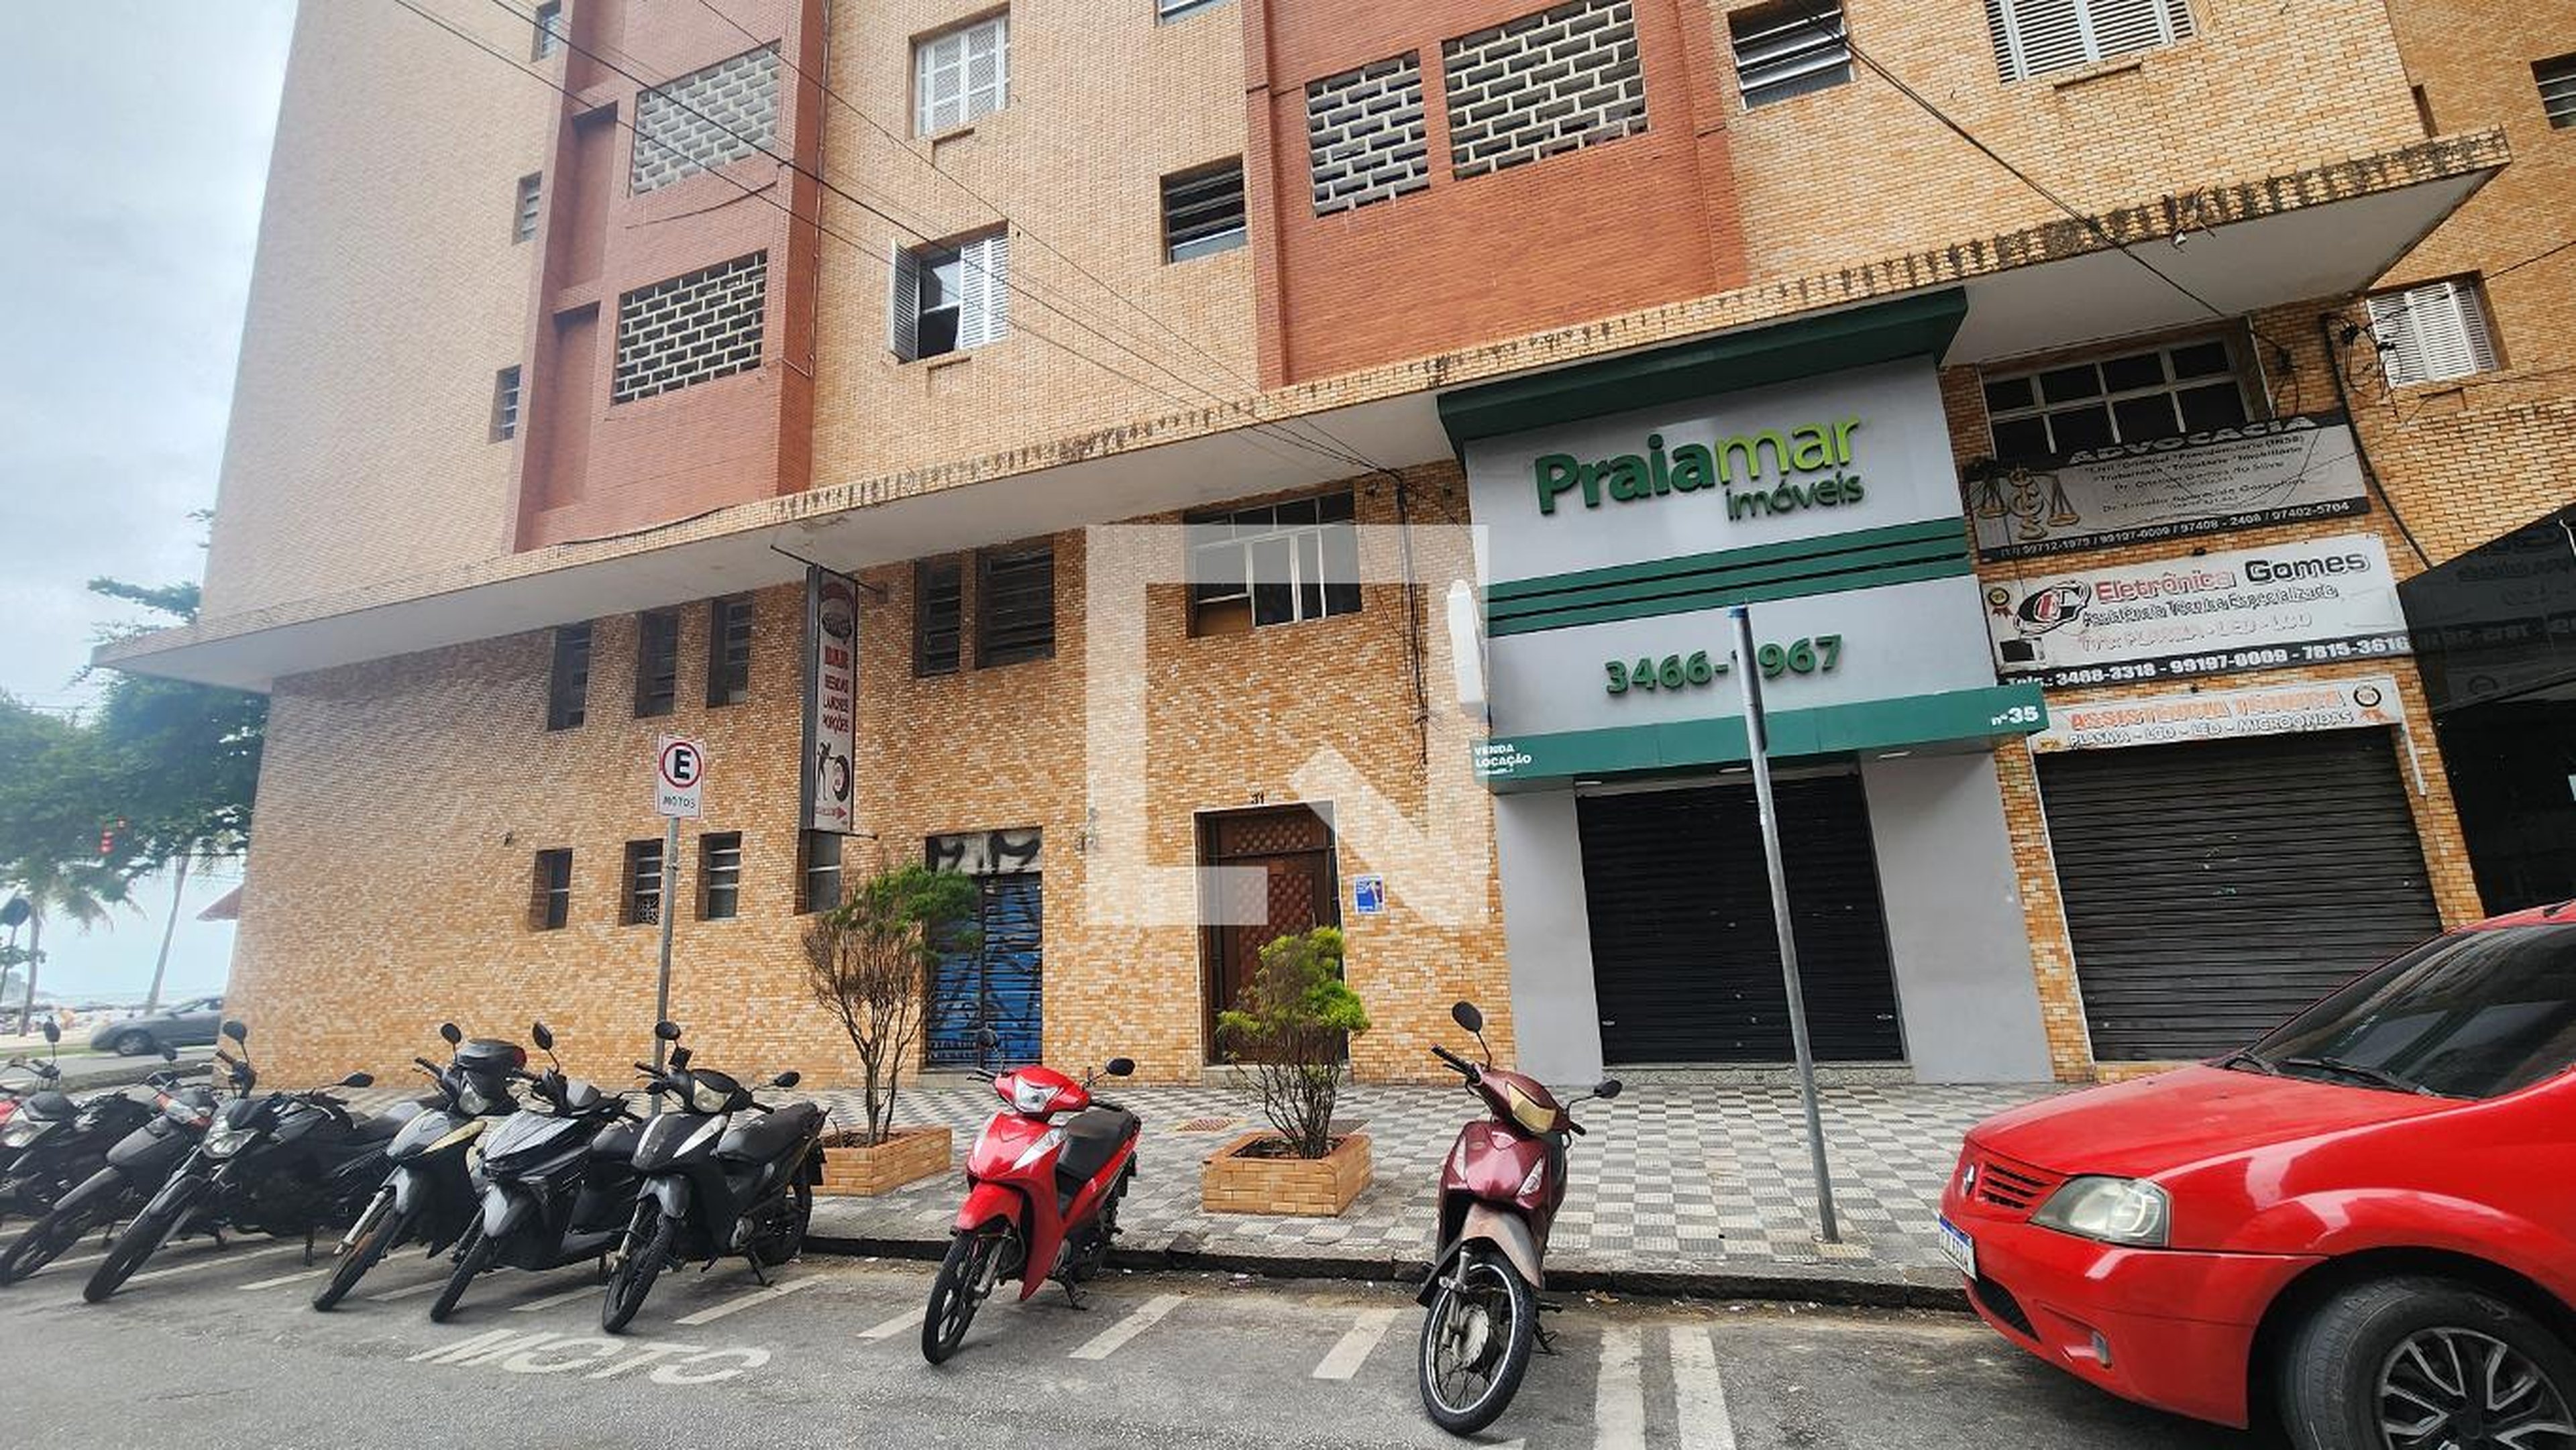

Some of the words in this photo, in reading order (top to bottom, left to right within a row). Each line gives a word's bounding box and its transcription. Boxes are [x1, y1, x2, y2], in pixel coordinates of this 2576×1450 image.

[2070, 416, 2317, 465] ADVOCACIA
[1536, 415, 1860, 515] Praiamar
[1726, 470, 1864, 521] imóveis
[2094, 570, 2237, 604] Eletrônica
[2245, 554, 2370, 583] Gomes
[1605, 634, 1842, 695] 3466-967
[2237, 711, 2354, 733] MICROONDAS
[674, 749, 691, 780] E
[1474, 743, 1515, 755] VENDA
[1476, 752, 1532, 767] LOCAÇÃO
[663, 796, 696, 809] MOTOS
[1251, 791, 1264, 804] 31
